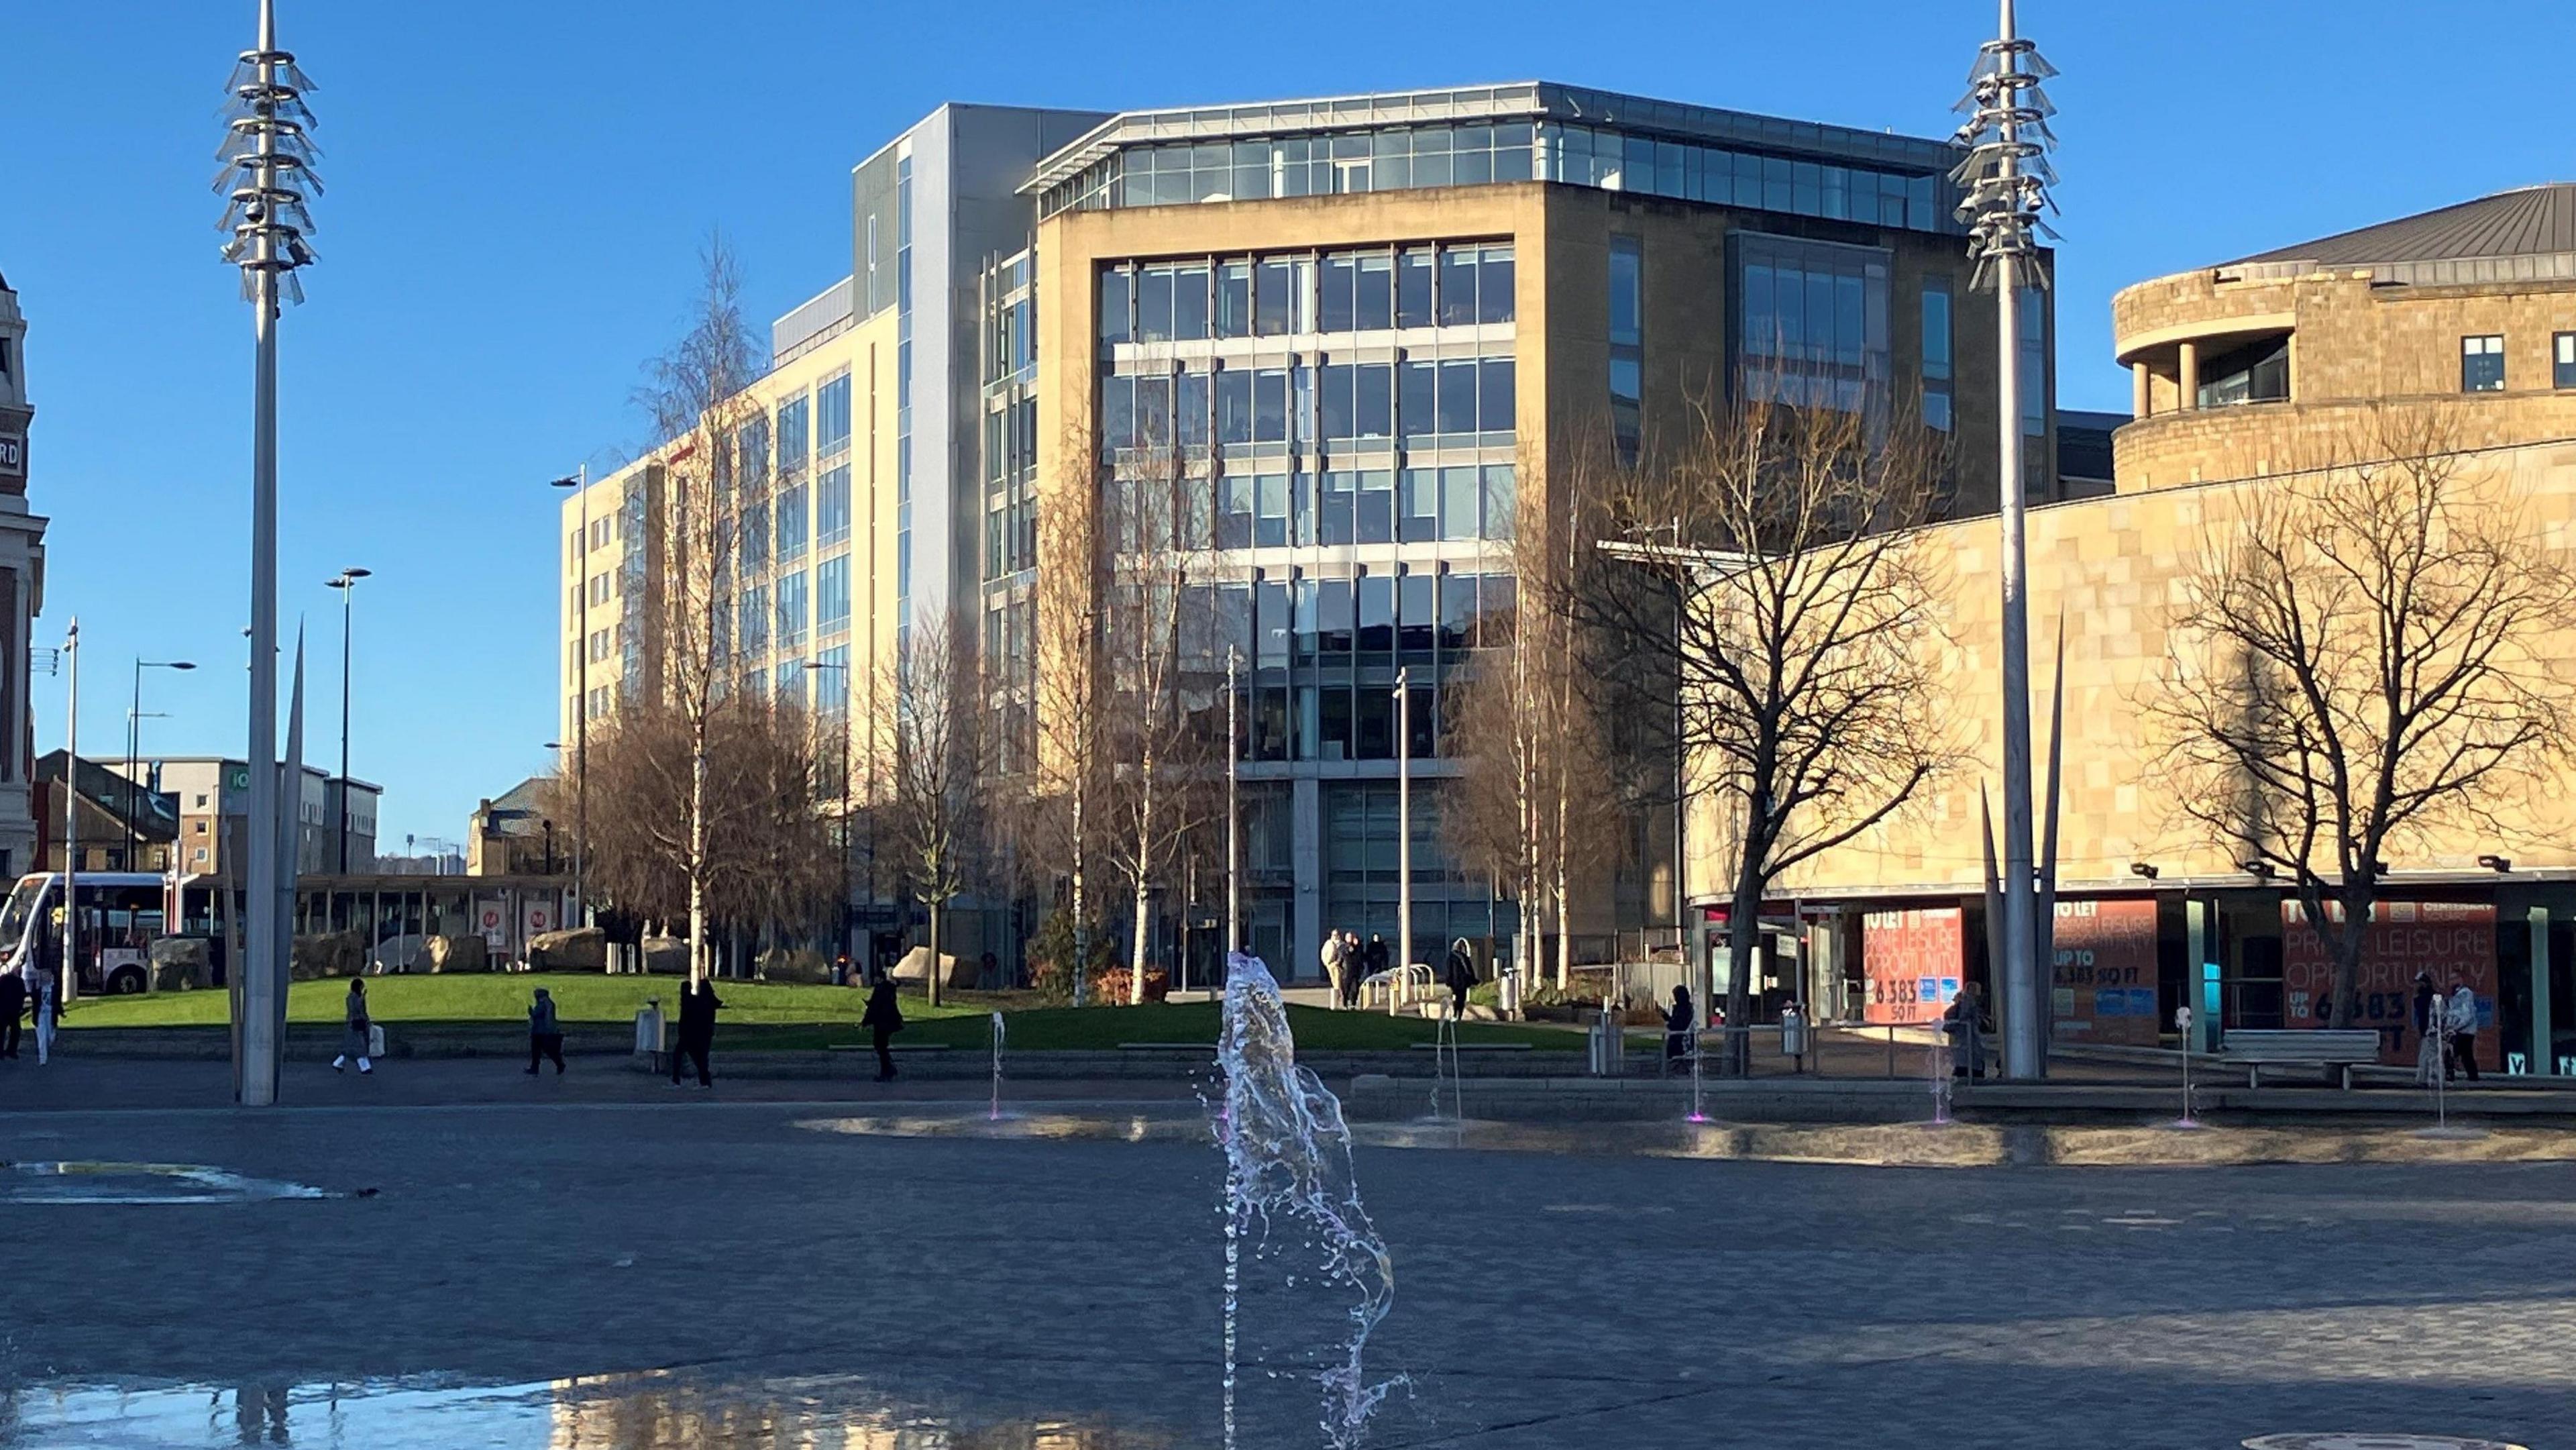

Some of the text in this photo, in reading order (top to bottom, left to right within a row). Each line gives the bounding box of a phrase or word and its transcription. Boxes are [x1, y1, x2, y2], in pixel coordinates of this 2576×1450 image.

[2053, 900, 2097, 917] TO LET
[1902, 927, 1957, 952] LEISURE
[2375, 929, 2490, 957] LEISURE
[1864, 951, 1957, 977] OPPORTUNITY
[2054, 949, 2094, 966] UP TO
[2124, 967, 2139, 984] FT
[1890, 1005, 1917, 1021] SQ FT
